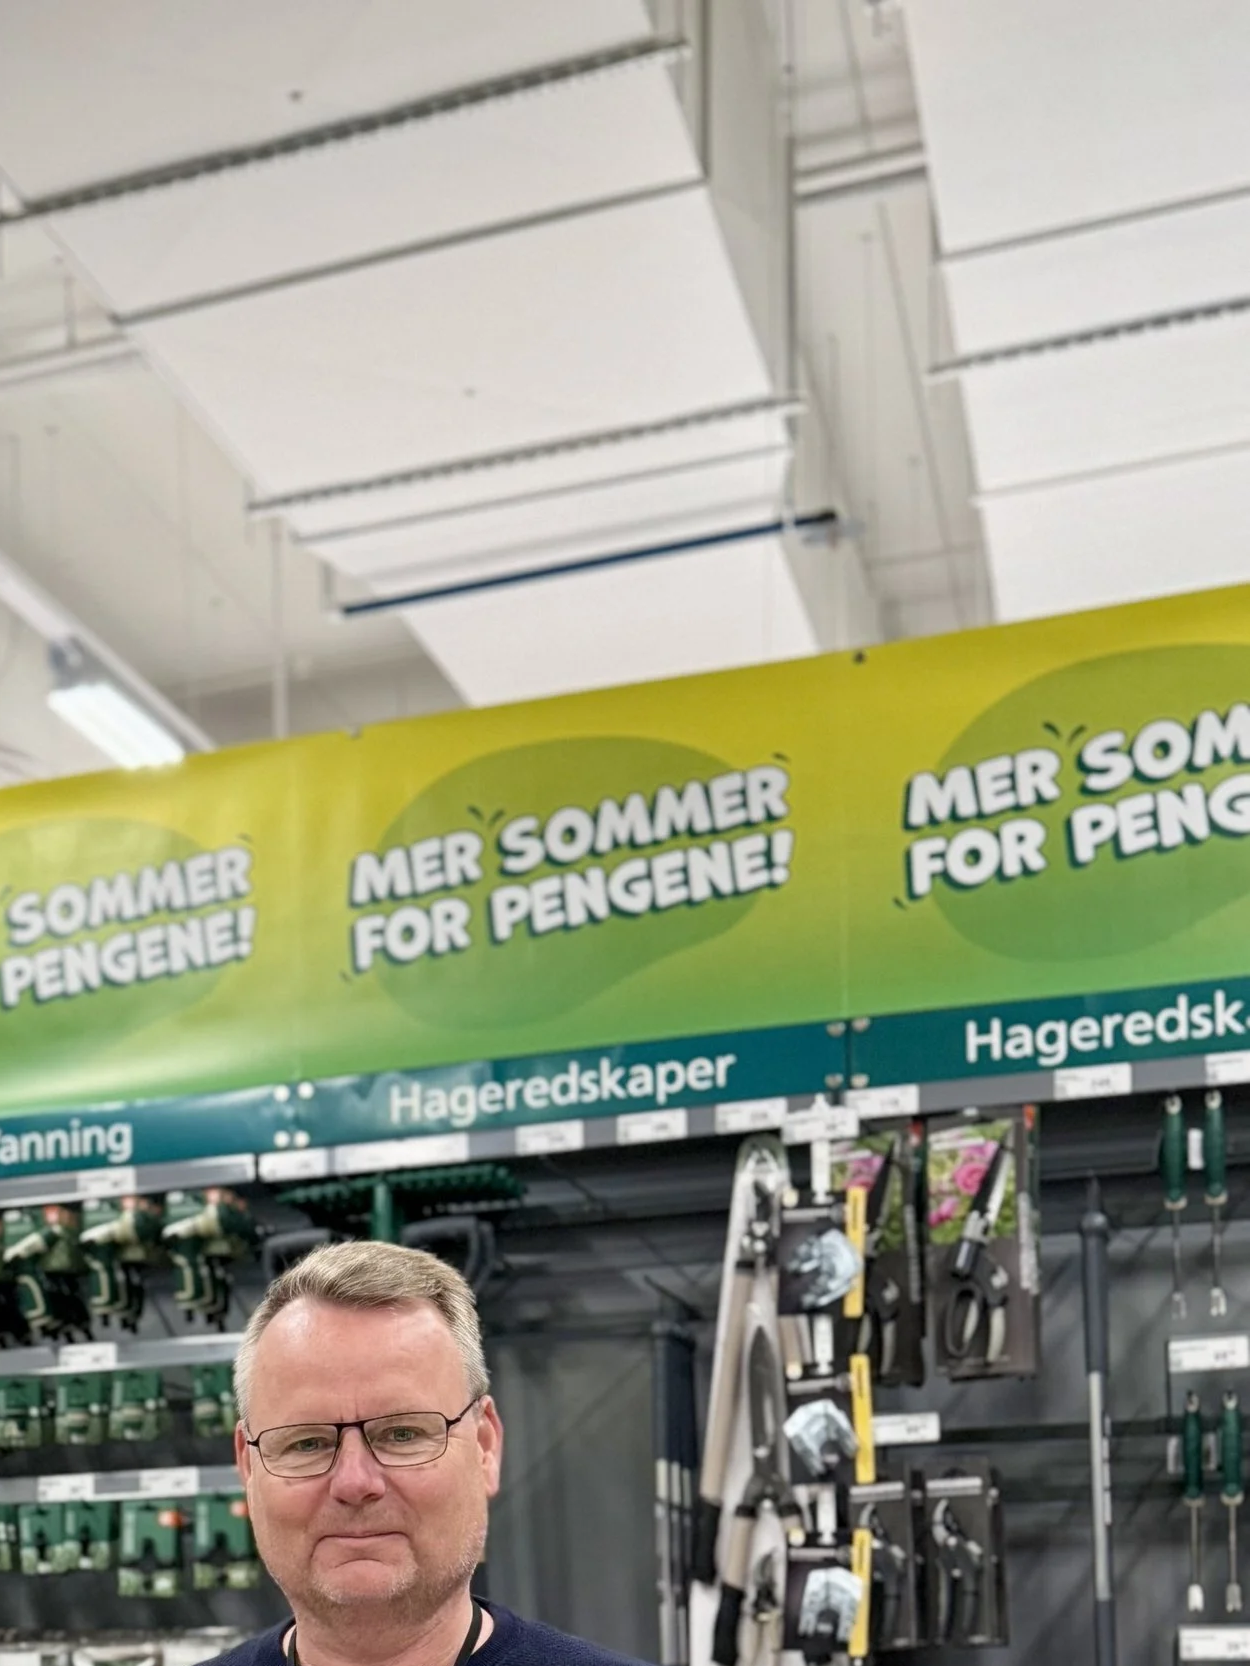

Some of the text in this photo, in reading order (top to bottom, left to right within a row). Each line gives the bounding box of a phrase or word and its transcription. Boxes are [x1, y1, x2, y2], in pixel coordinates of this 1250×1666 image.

[906, 747, 1061, 828] MER
[351, 767, 791, 907] MER SOMMER
[908, 818, 1047, 897] FOR
[8, 847, 253, 947] SOMMER
[353, 831, 793, 972] FOR PENGENE!
[0, 908, 257, 1008] PENGENE!
[965, 989, 1250, 1067] Hageredsk
[389, 1053, 736, 1129] Hageredskaper
